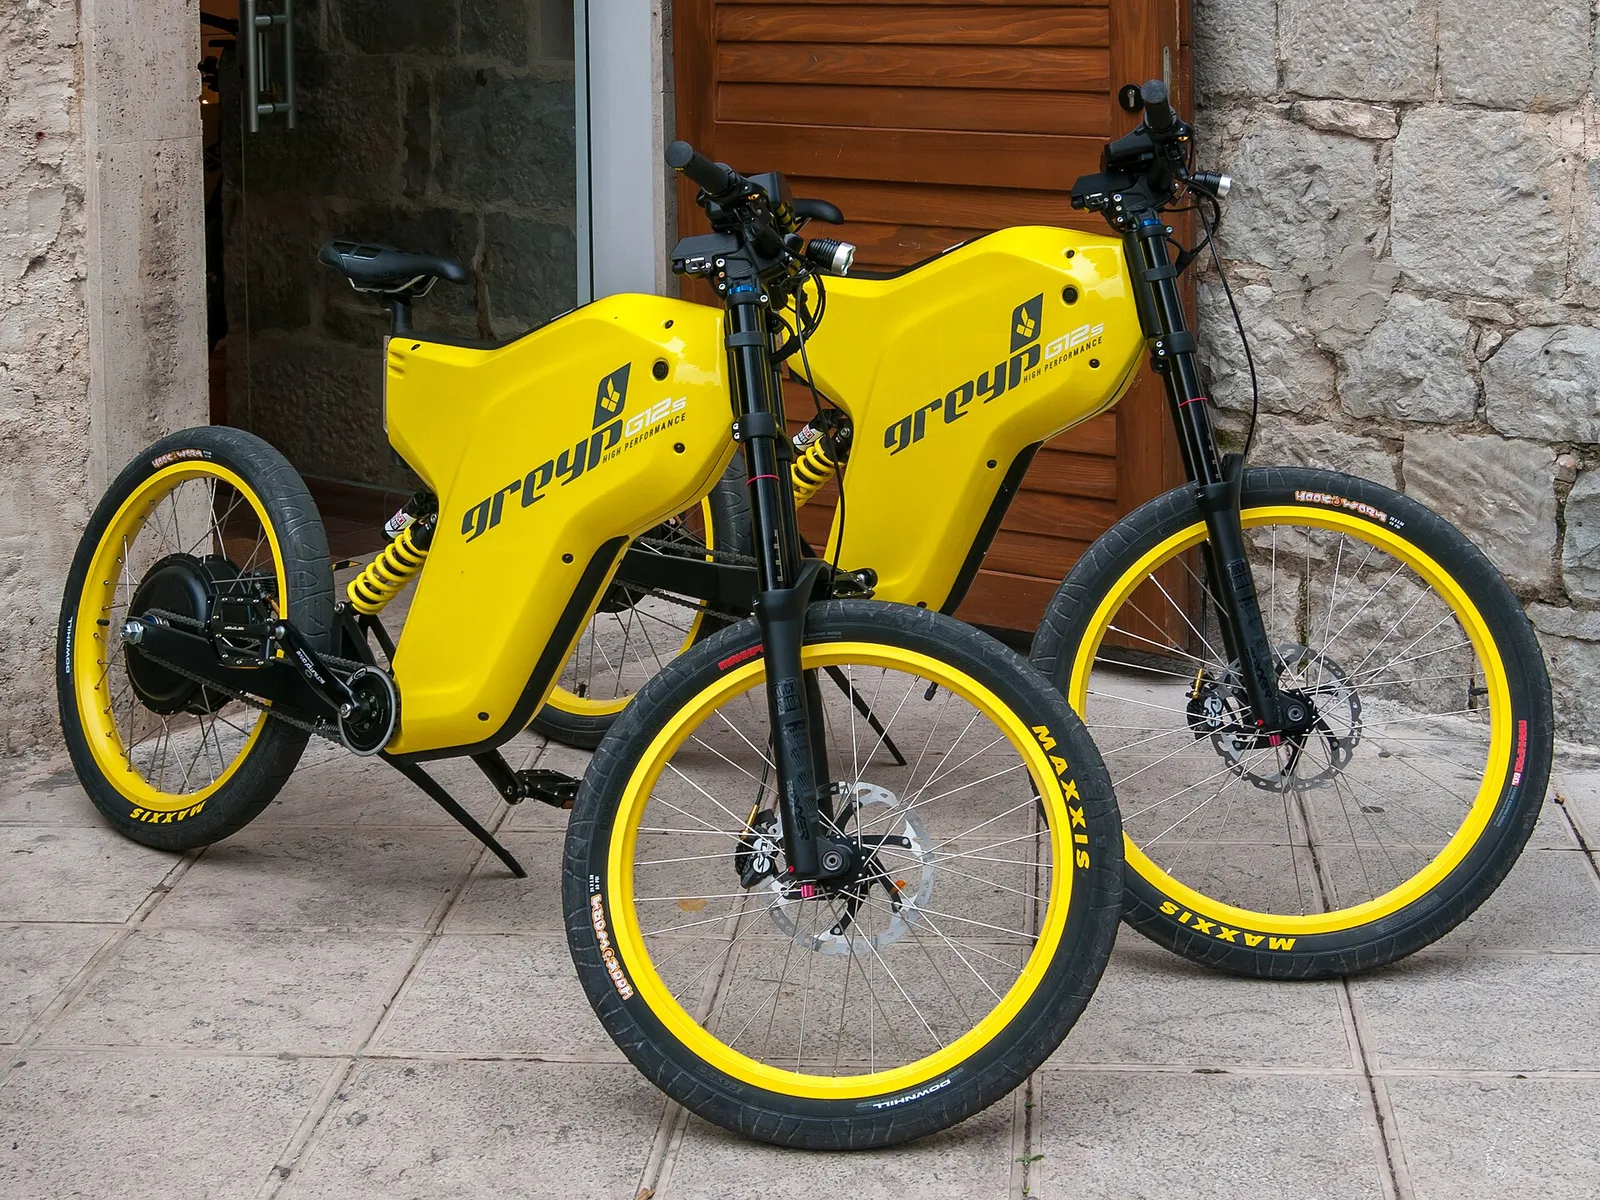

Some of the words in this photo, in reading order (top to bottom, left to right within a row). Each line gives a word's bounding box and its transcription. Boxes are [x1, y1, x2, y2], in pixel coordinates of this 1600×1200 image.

[1023, 367, 1042, 384] HIGH
[1044, 335, 1103, 372] PERFORMANCE
[884, 343, 1042, 456] greyp
[602, 446, 622, 464] HIGH
[624, 412, 687, 452] PERFORMANCE
[461, 419, 623, 544] greyp
[65, 616, 74, 674] DOWNHILL
[129, 800, 207, 823] MAXXIS
[1031, 724, 1091, 870] MAXXIS
[1158, 900, 1297, 951] MAXXIS
[872, 1078, 951, 1109] DOWNHILL
